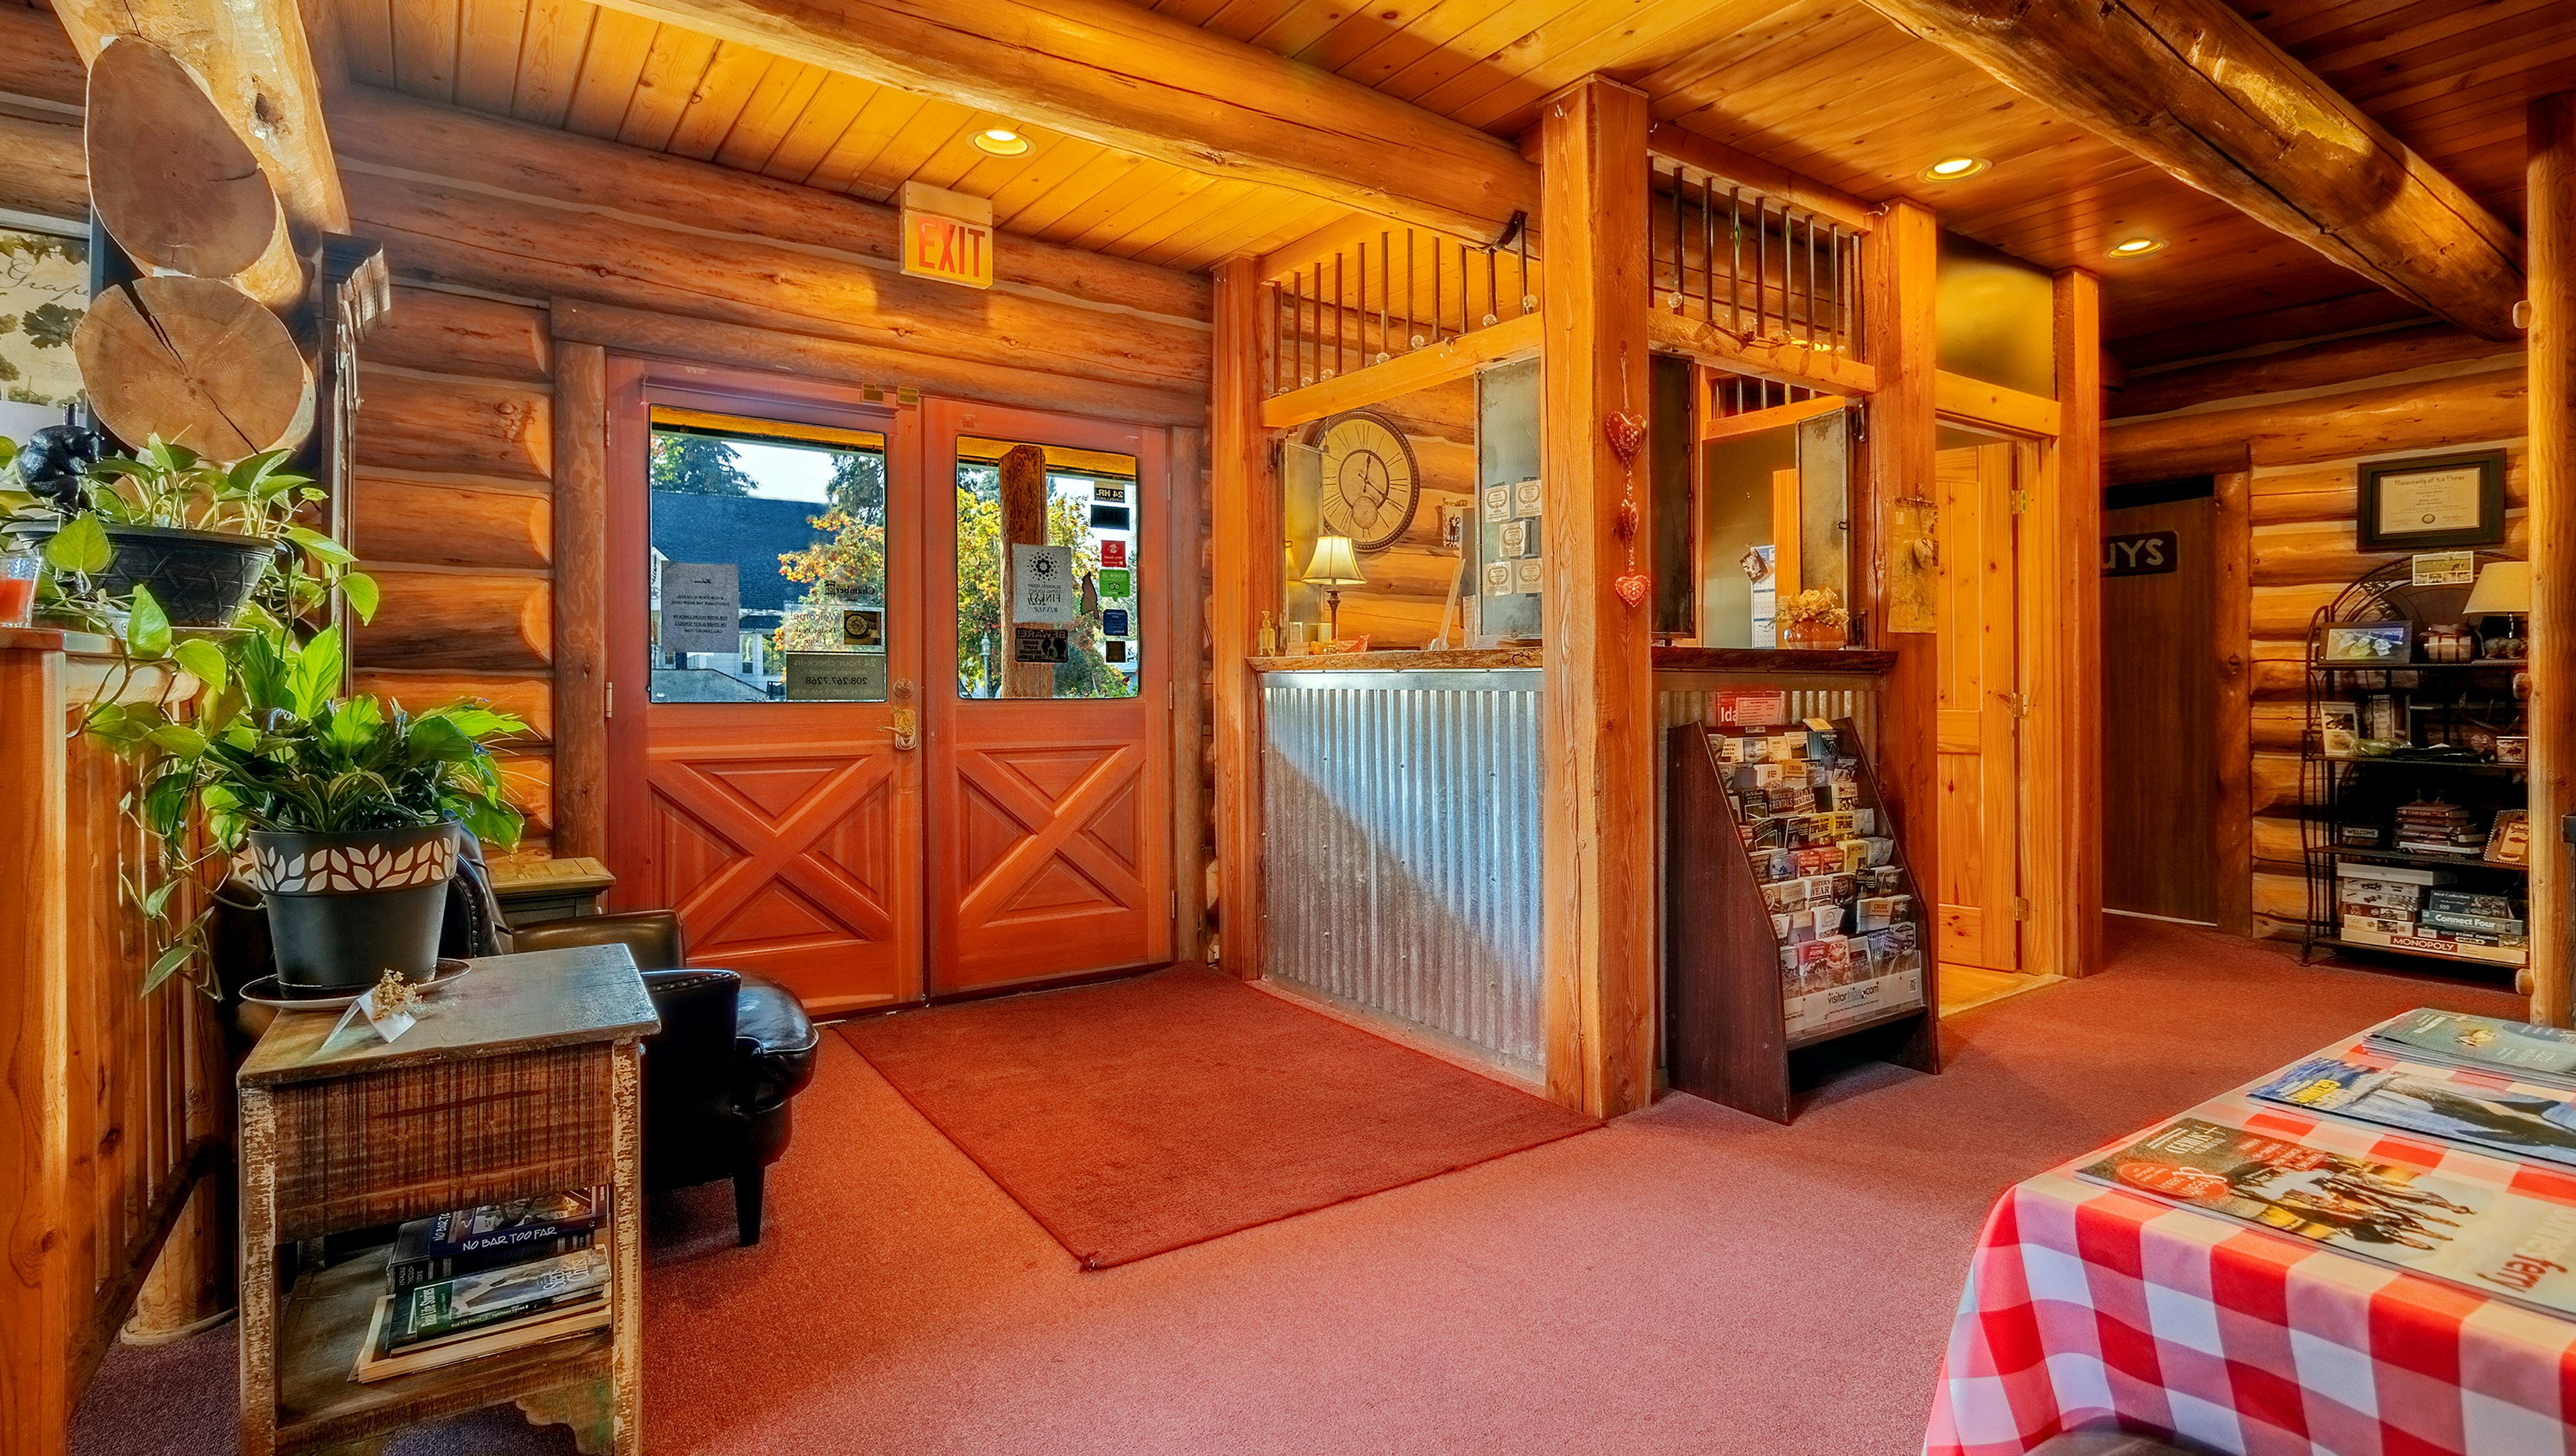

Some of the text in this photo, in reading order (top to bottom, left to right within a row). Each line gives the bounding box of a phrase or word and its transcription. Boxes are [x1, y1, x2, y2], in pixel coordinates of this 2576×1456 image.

[918, 217, 985, 277] EXIT
[2100, 538, 2164, 569] UYS
[1794, 788, 1813, 798] BOAT
[1772, 798, 1793, 809] RENTALS
[1810, 823, 1829, 834] ZIPLINE
[1835, 819, 1853, 829] ZIPLINE
[2434, 915, 2496, 929] Connect Four
[1831, 941, 1847, 951] ANDY
[2393, 937, 2454, 951] MONOPOLY
[463, 1227, 558, 1251] NO BAR TOO FAR
[421, 1314, 437, 1327] Real
